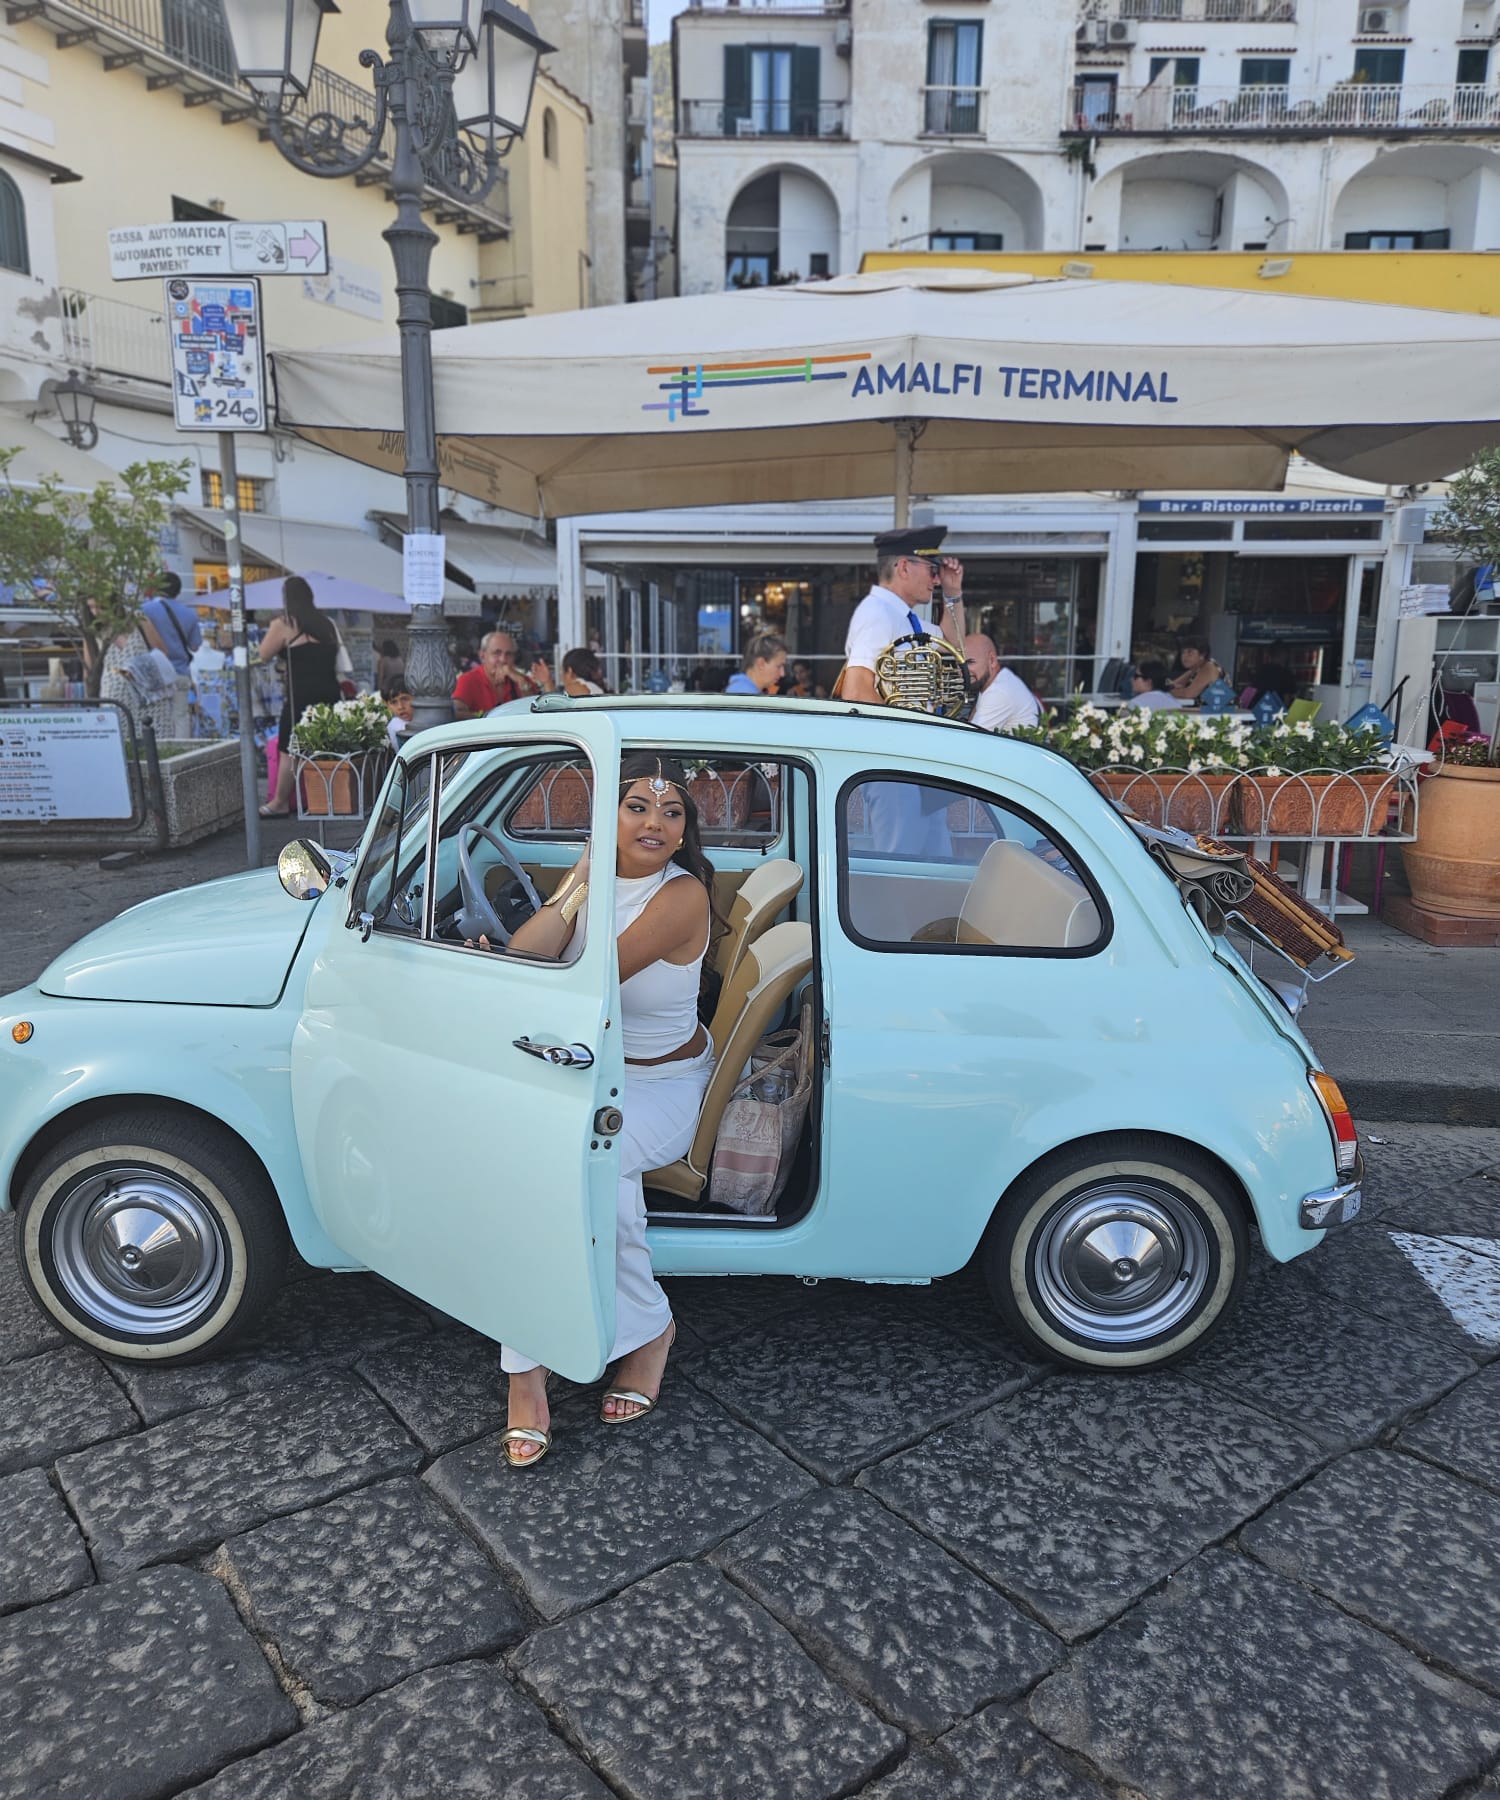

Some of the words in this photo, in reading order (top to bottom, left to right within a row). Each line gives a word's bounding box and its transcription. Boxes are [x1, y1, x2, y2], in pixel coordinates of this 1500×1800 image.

[109, 231, 143, 244] CASSA
[148, 226, 227, 241] AUTOMATICA
[113, 247, 173, 261] AUTOMATIC
[175, 245, 222, 257] TICKET
[139, 260, 190, 273] PAYMENT
[851, 362, 983, 398] AMALFI
[998, 366, 1179, 403] TERMINAL
[215, 399, 242, 418] 24
[1160, 502, 1188, 513] Bar
[1201, 500, 1286, 513] Ristorante
[1299, 500, 1364, 513] Pizzeria
